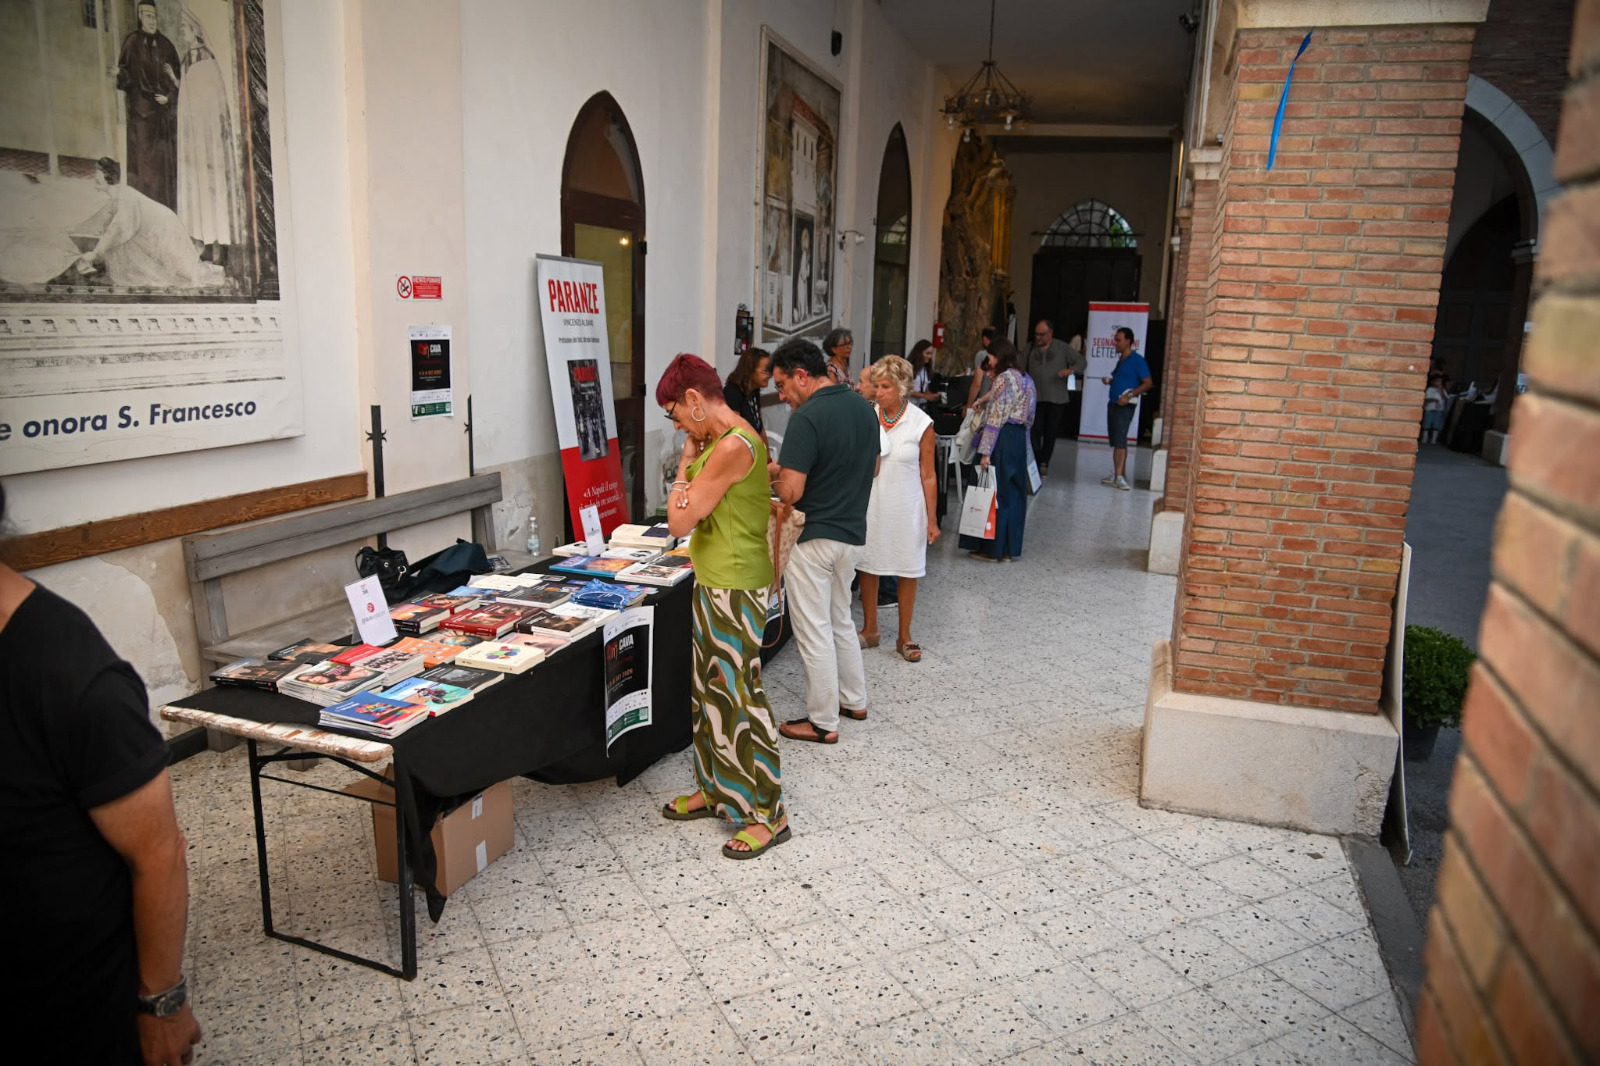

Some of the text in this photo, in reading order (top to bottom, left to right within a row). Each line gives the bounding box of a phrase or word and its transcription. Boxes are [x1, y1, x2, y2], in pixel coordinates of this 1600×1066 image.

[548, 279, 599, 314] PARANZE
[22, 413, 108, 438] onora
[117, 405, 140, 429] S.
[149, 400, 257, 426] Francesco
[619, 634, 635, 650] CAVA
